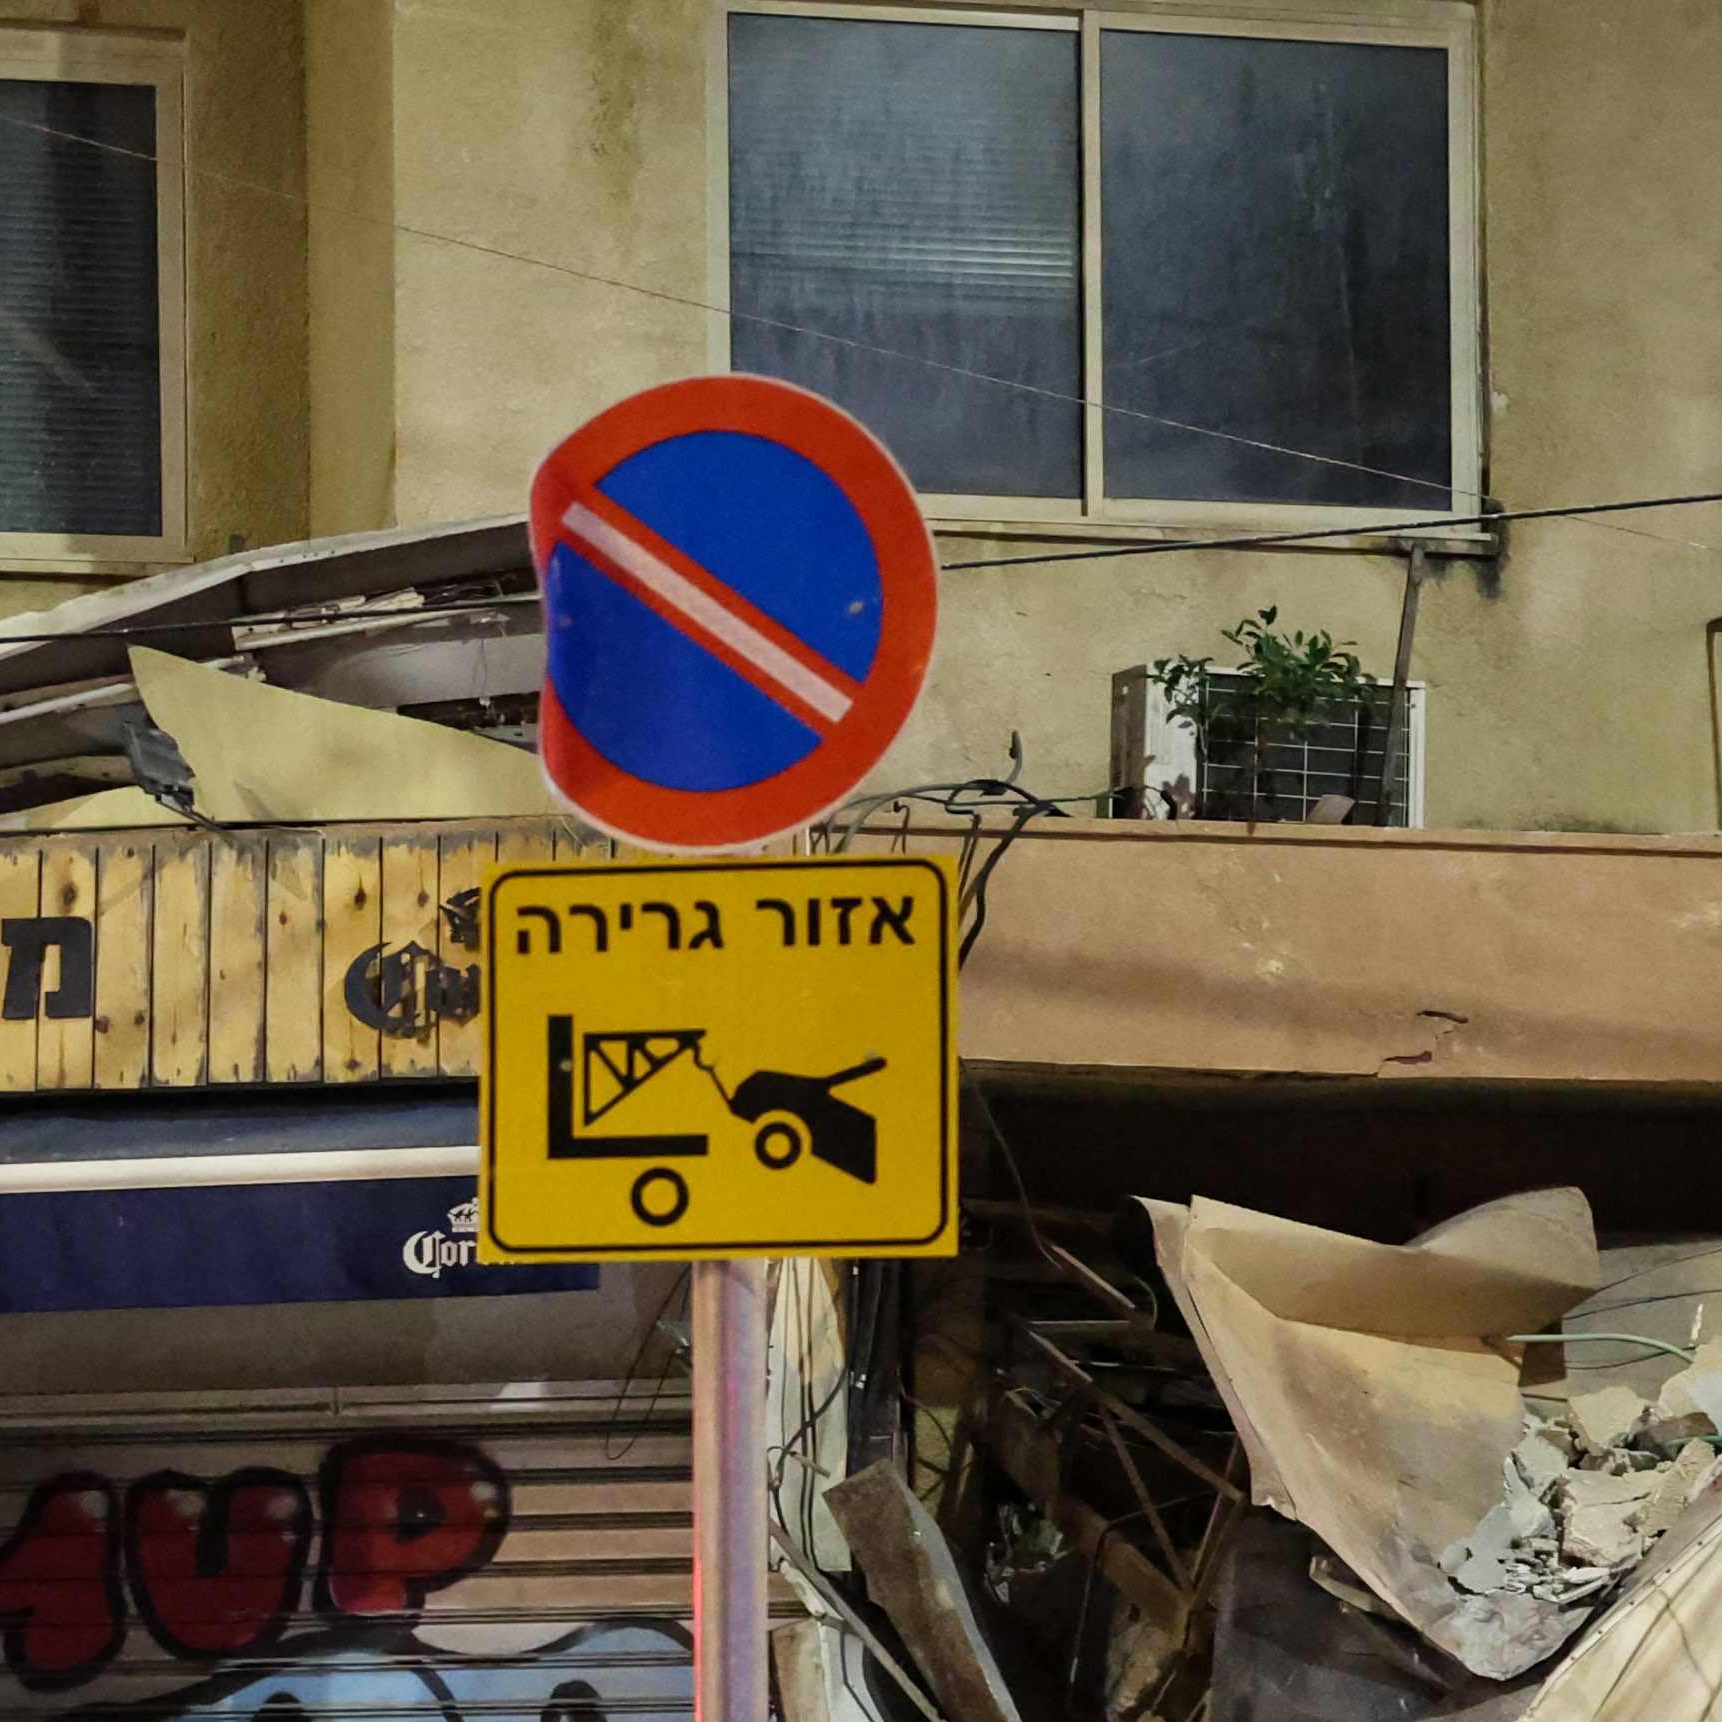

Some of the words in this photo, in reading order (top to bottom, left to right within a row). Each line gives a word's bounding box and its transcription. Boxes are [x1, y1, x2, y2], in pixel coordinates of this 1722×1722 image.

[516, 901, 724, 954] גרירה
[757, 896, 915, 946] אזור
[402, 1230, 477, 1278] Cor
